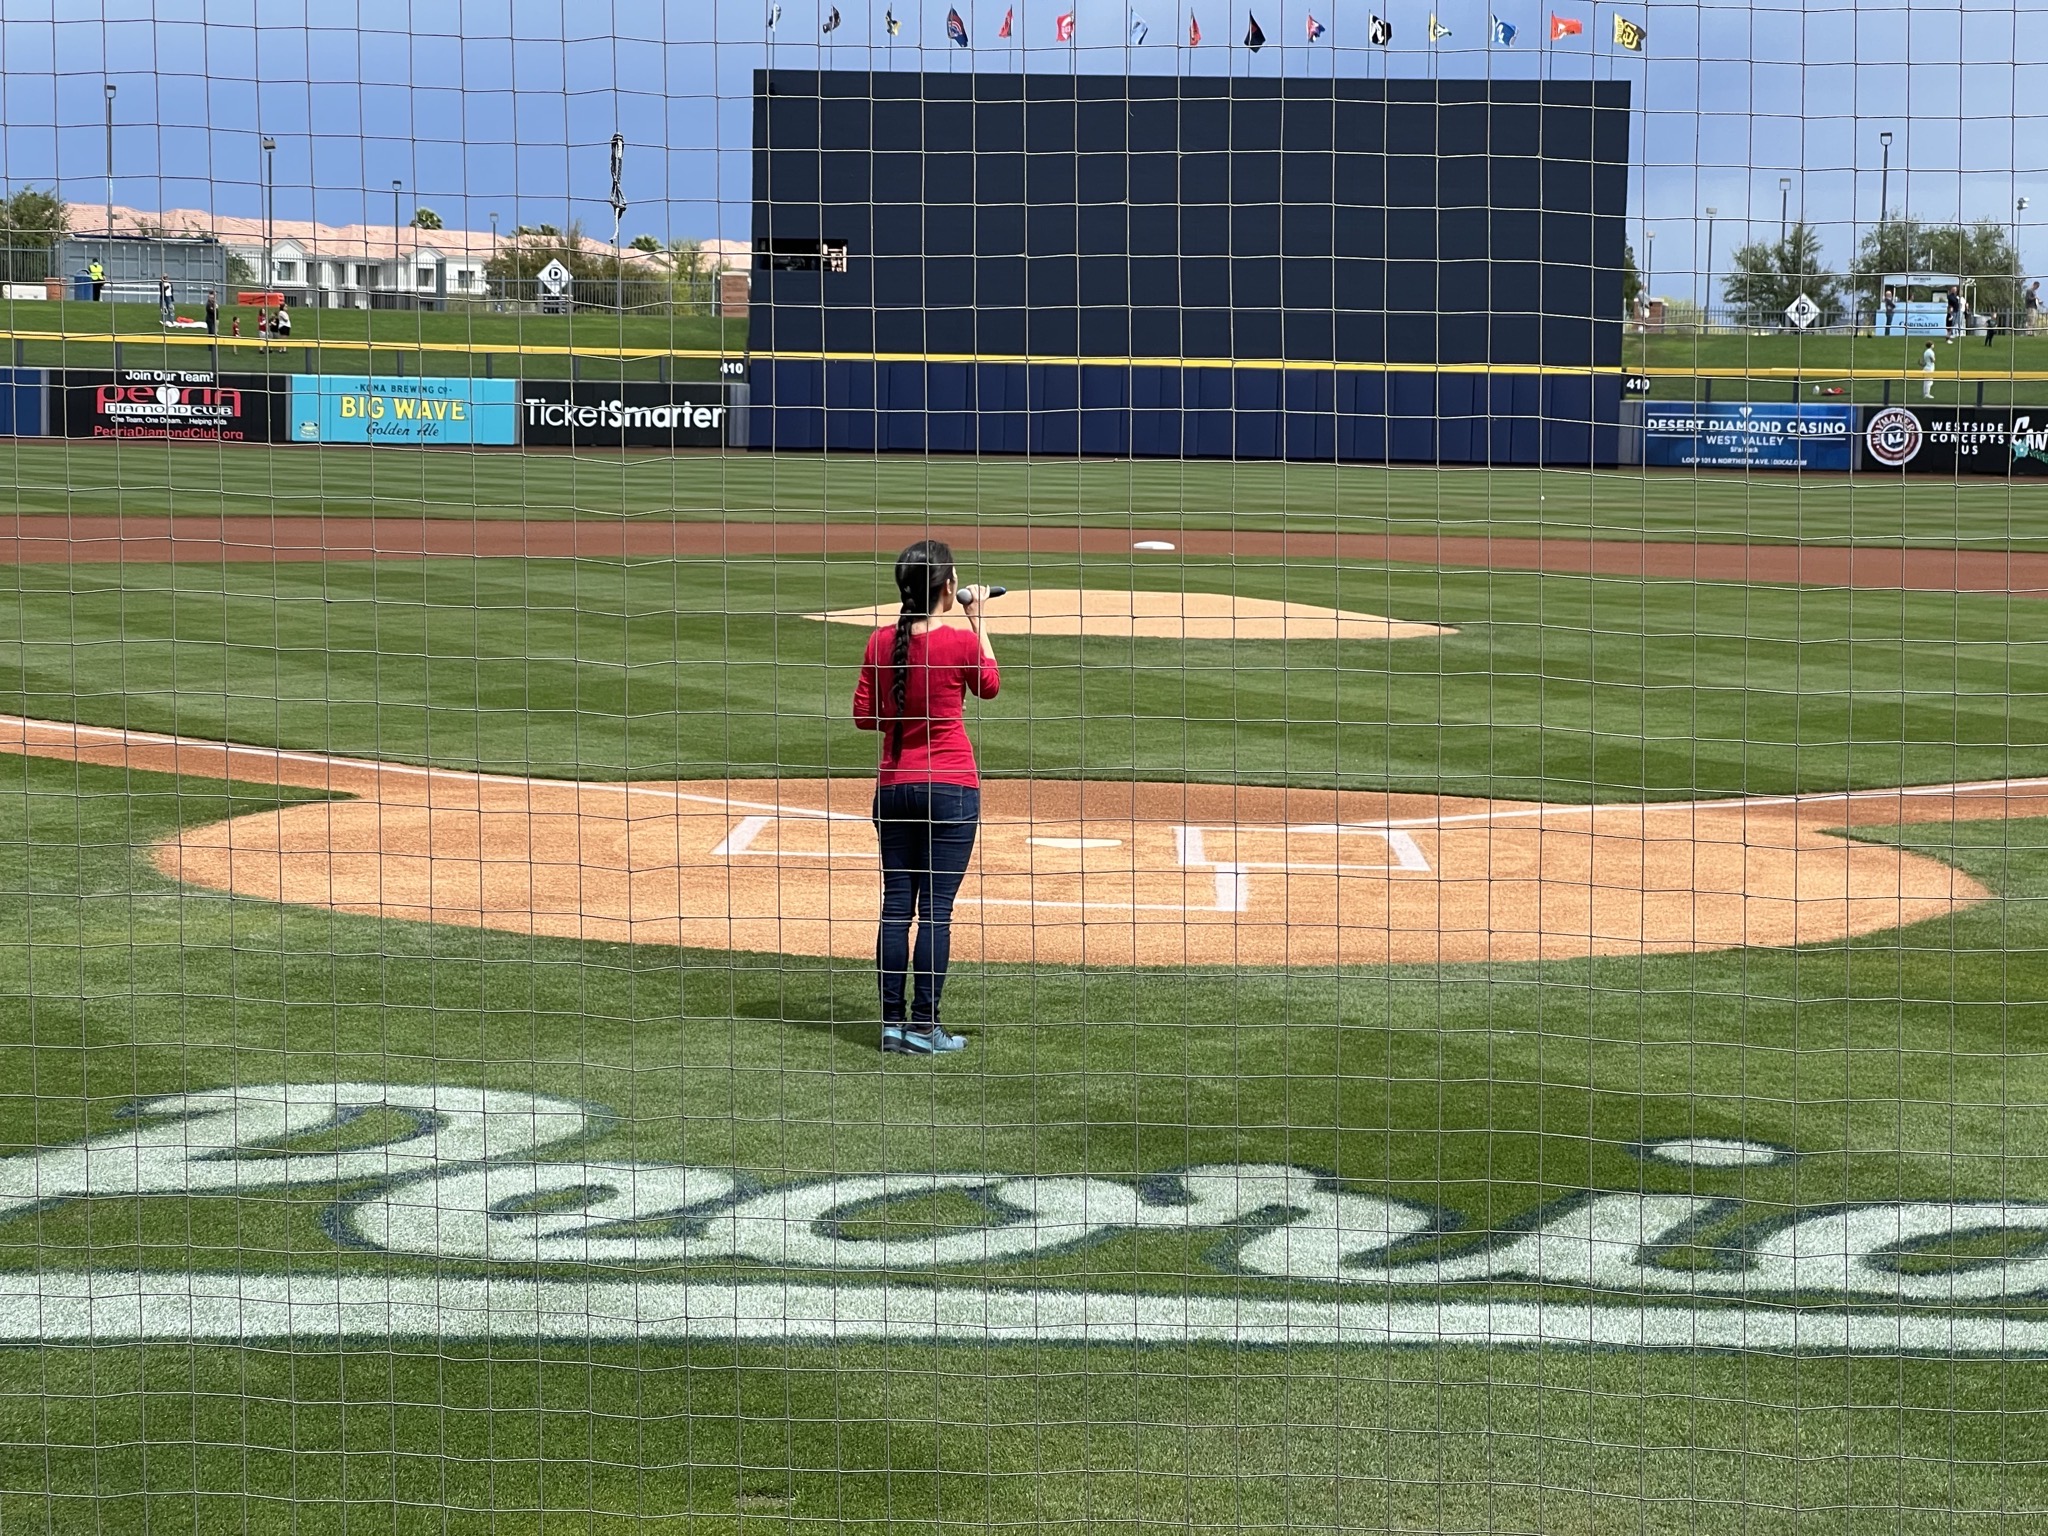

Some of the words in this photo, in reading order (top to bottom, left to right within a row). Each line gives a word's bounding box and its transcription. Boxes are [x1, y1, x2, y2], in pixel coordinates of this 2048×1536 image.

[720, 363, 744, 375] 410
[125, 370, 151, 381] Join
[153, 371, 177, 381] Our
[180, 371, 214, 382] Team!
[360, 383, 386, 392] KONA
[391, 384, 434, 393] BREWING
[1626, 378, 1650, 390] 410
[107, 404, 189, 415] DIAMOND
[192, 405, 233, 416] CLUB
[340, 395, 385, 419] BIG
[393, 397, 466, 421] WAVE
[525, 397, 726, 428] TicketSmarter
[145, 416, 159, 424] One
[1647, 418, 1704, 432] DESERT
[1709, 420, 1782, 433] DIAMOND
[1786, 421, 1846, 434] CASINO
[366, 420, 410, 437] Golden
[416, 422, 439, 437] Ale
[1931, 421, 2004, 432] WESTSIDE
[1706, 435, 1738, 445] WEST
[1741, 436, 1784, 446] VALLEY
[1930, 433, 2005, 445] CONCEPTS
